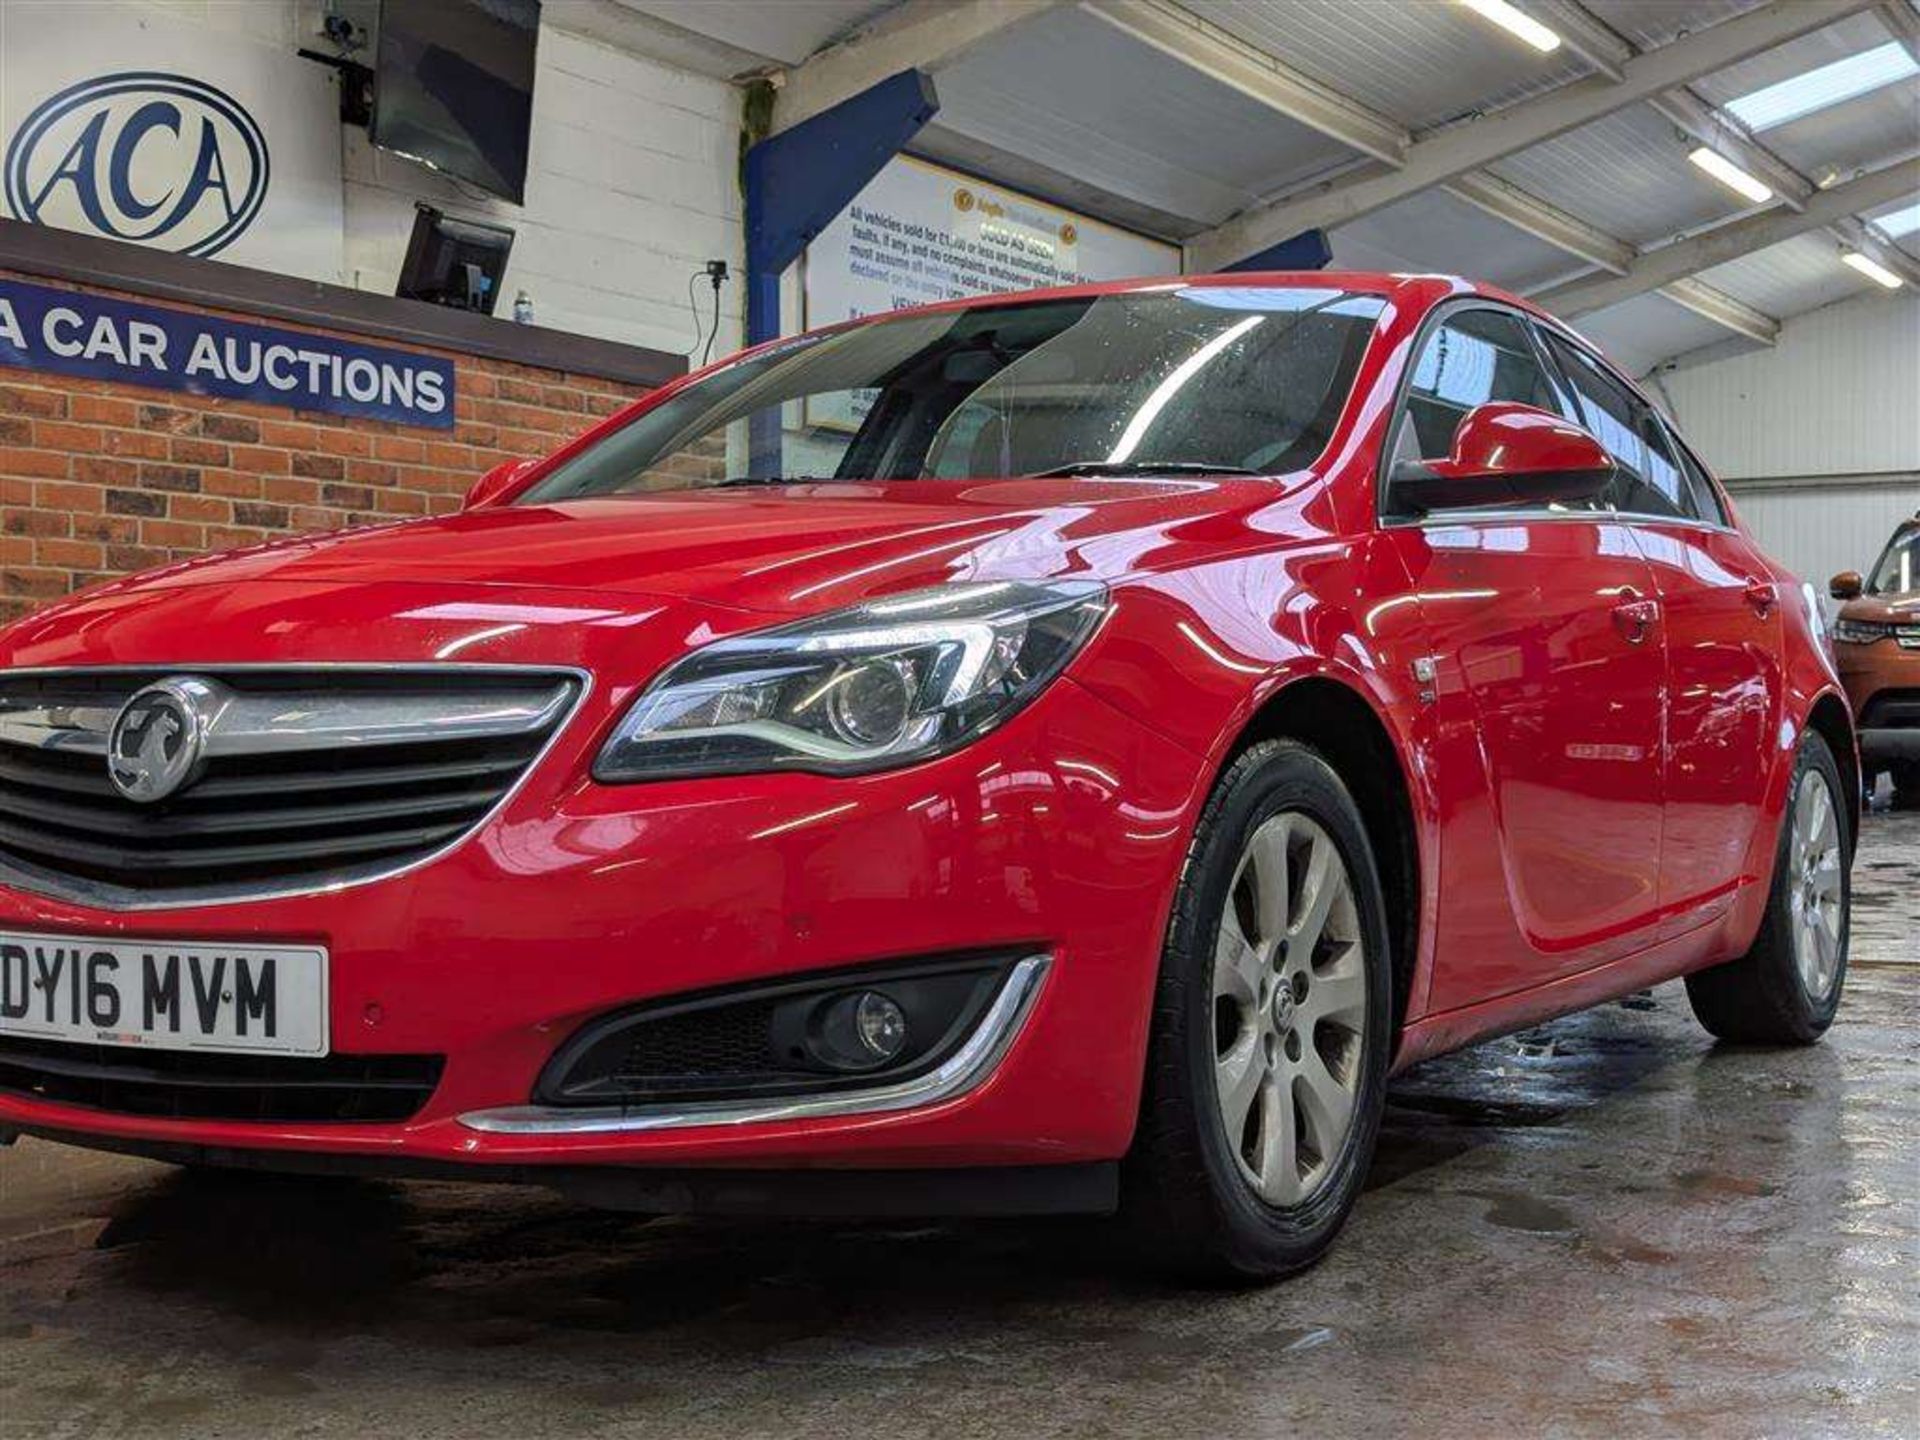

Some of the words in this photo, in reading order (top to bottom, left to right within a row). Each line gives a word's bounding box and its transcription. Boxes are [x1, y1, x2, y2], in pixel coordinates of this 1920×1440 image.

[32, 101, 237, 239] ACA
[850, 244, 873, 260] must
[875, 251, 910, 271] assume
[864, 211, 902, 232] vehicles
[904, 223, 923, 239] sold
[924, 226, 938, 242] for
[912, 244, 929, 258] and
[930, 250, 941, 262] no
[42, 307, 168, 371] CAR
[185, 333, 446, 413] AUCTIONS
[0, 944, 121, 1028] DY16
[142, 954, 276, 1038] MVM
